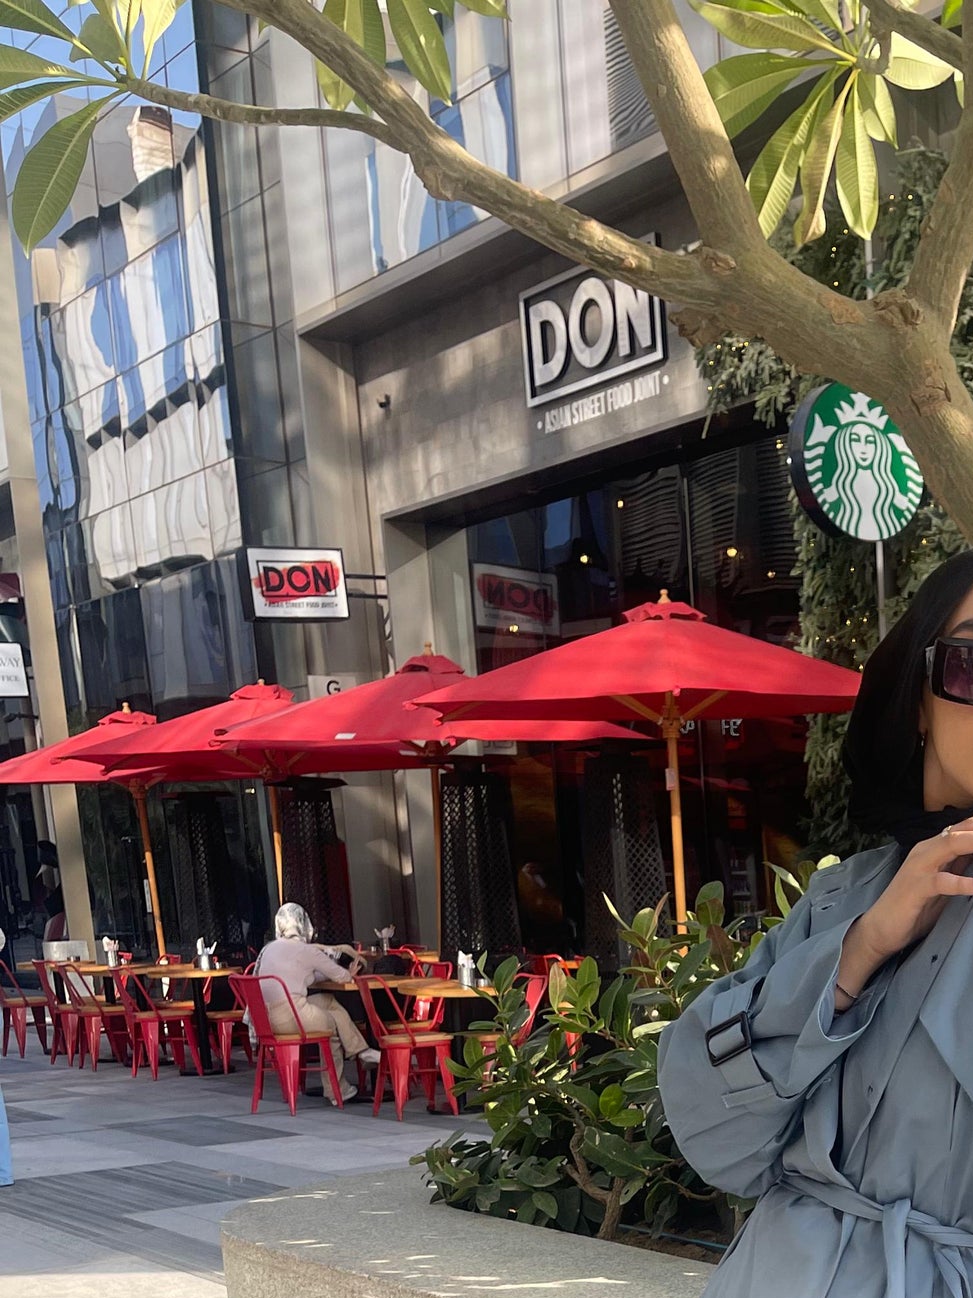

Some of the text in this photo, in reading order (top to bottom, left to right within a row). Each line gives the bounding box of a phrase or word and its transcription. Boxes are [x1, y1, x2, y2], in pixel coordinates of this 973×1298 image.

[529, 277, 652, 386] DON
[572, 391, 605, 425] STREET
[607, 382, 632, 412] FOOD
[263, 566, 332, 592] DON
